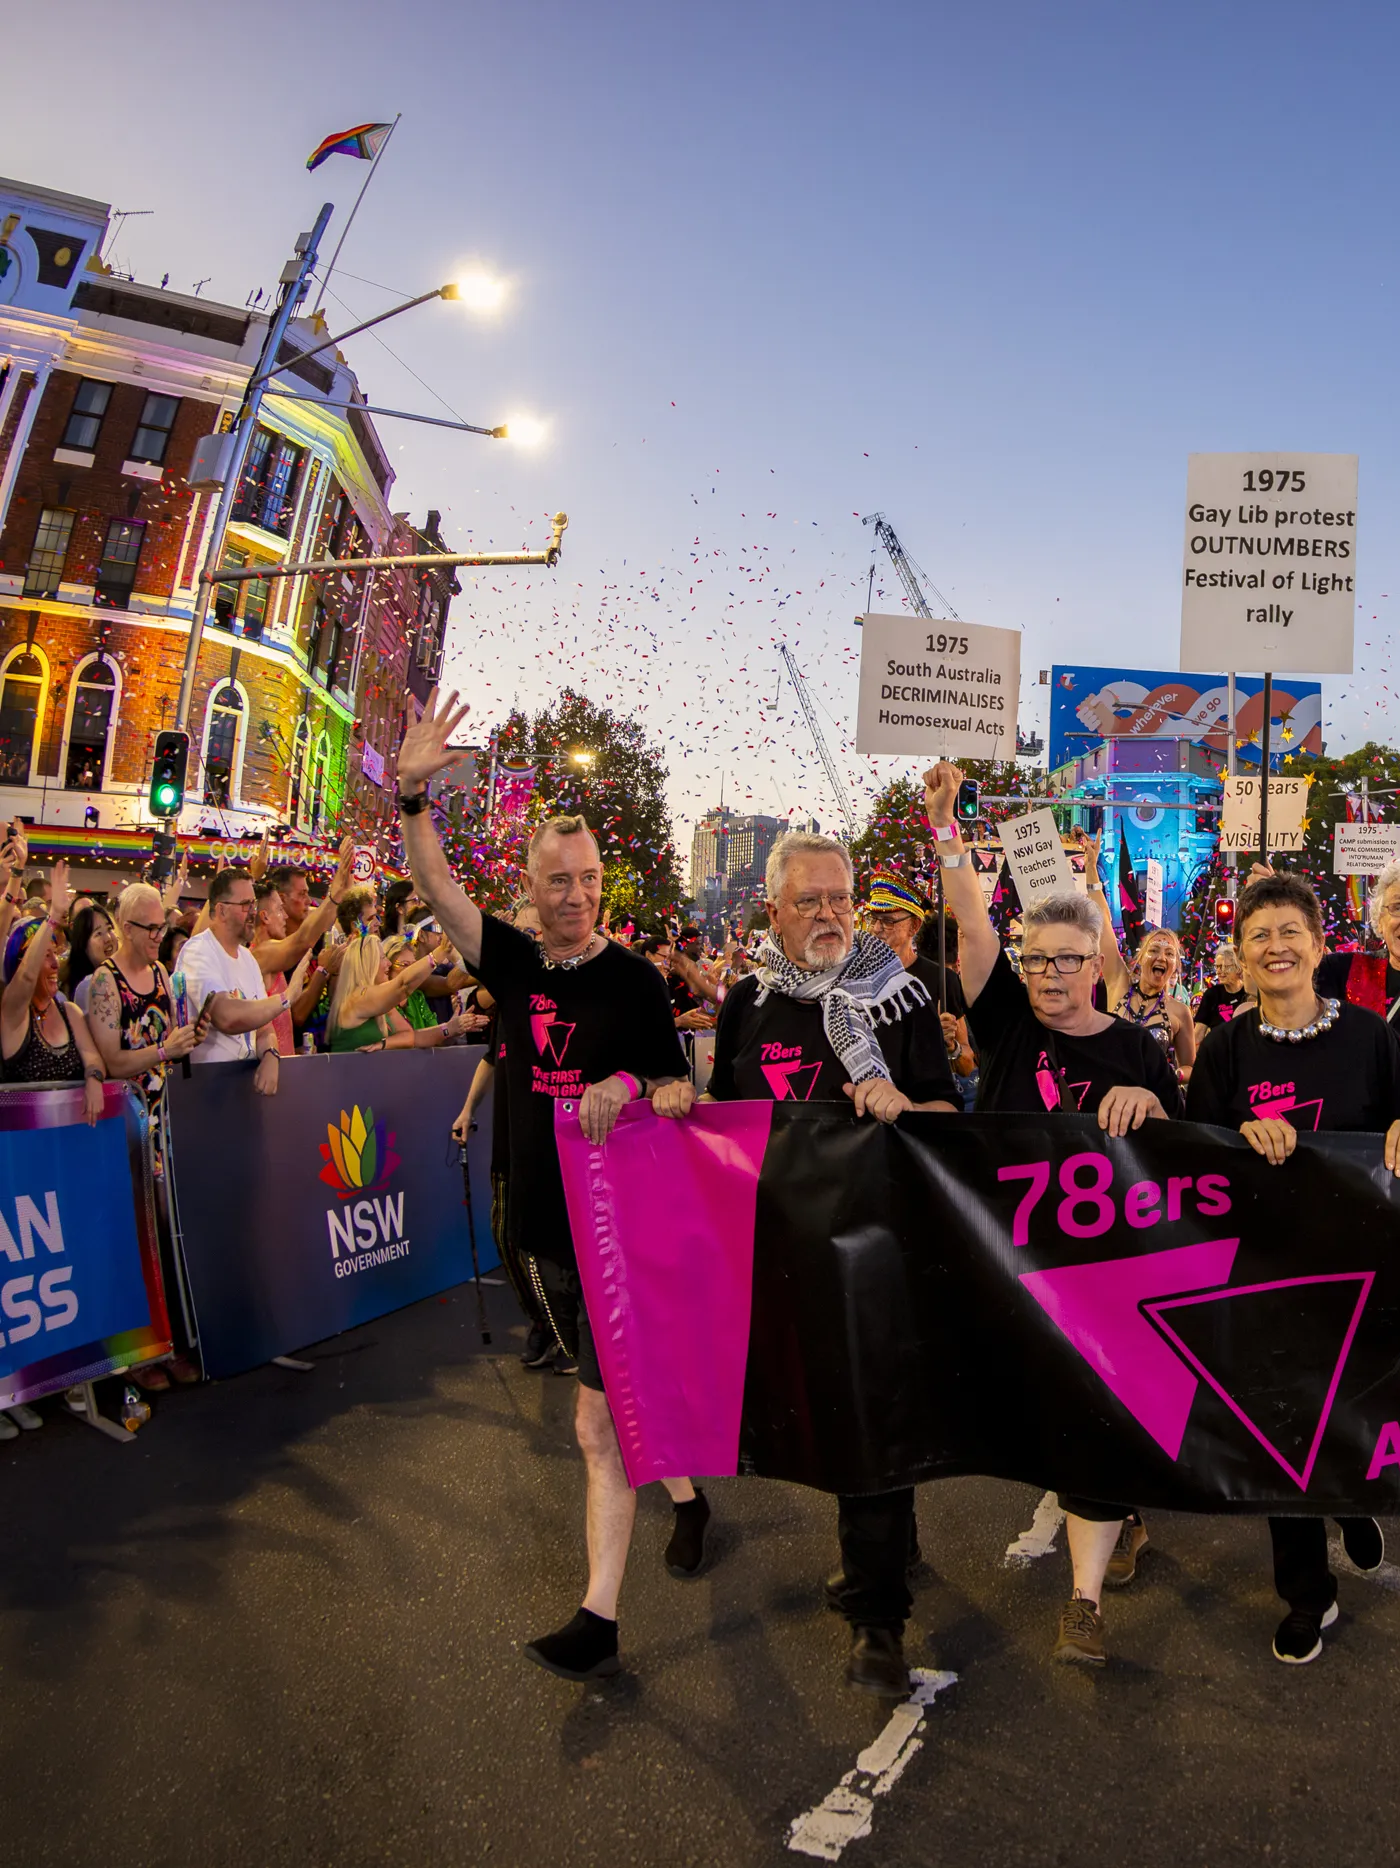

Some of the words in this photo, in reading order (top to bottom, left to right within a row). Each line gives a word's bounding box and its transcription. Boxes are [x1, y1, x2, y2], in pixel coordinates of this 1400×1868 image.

[1243, 469, 1306, 492] 1975
[1189, 504, 1231, 527] Gay
[1239, 505, 1268, 523] Lib
[1275, 509, 1356, 528] protest
[1190, 536, 1351, 558] OUTNUMBERS
[1185, 568, 1265, 589] Festival
[1272, 571, 1295, 589] of
[1301, 572, 1353, 595] Light
[1246, 604, 1294, 627] rally
[925, 634, 969, 655] 1975
[887, 660, 932, 677] South
[936, 664, 1001, 685] Australia
[881, 684, 1005, 711] DECRIMINALISES
[879, 709, 972, 731] Homosexual
[975, 719, 1005, 736] Acts
[1130, 693, 1178, 735] wherever
[1206, 697, 1221, 712] go
[1236, 781, 1253, 796] 50
[1014, 821, 1040, 840] 1975
[1226, 832, 1299, 847] VISIBLITY
[1358, 826, 1377, 834] 1975
[1013, 844, 1034, 859] NSW
[1035, 840, 1053, 852] Gay
[1017, 857, 1056, 875] Teachers
[1029, 874, 1056, 888] Group
[761, 1042, 802, 1061] 78ers
[550, 1070, 582, 1084] FIRST
[1247, 1081, 1295, 1104] 78ers
[997, 1152, 1232, 1246] 78ers
[327, 1191, 404, 1258] NSW
[334, 1240, 410, 1278] GOVERNMENT
[0, 1265, 79, 1349] SS
